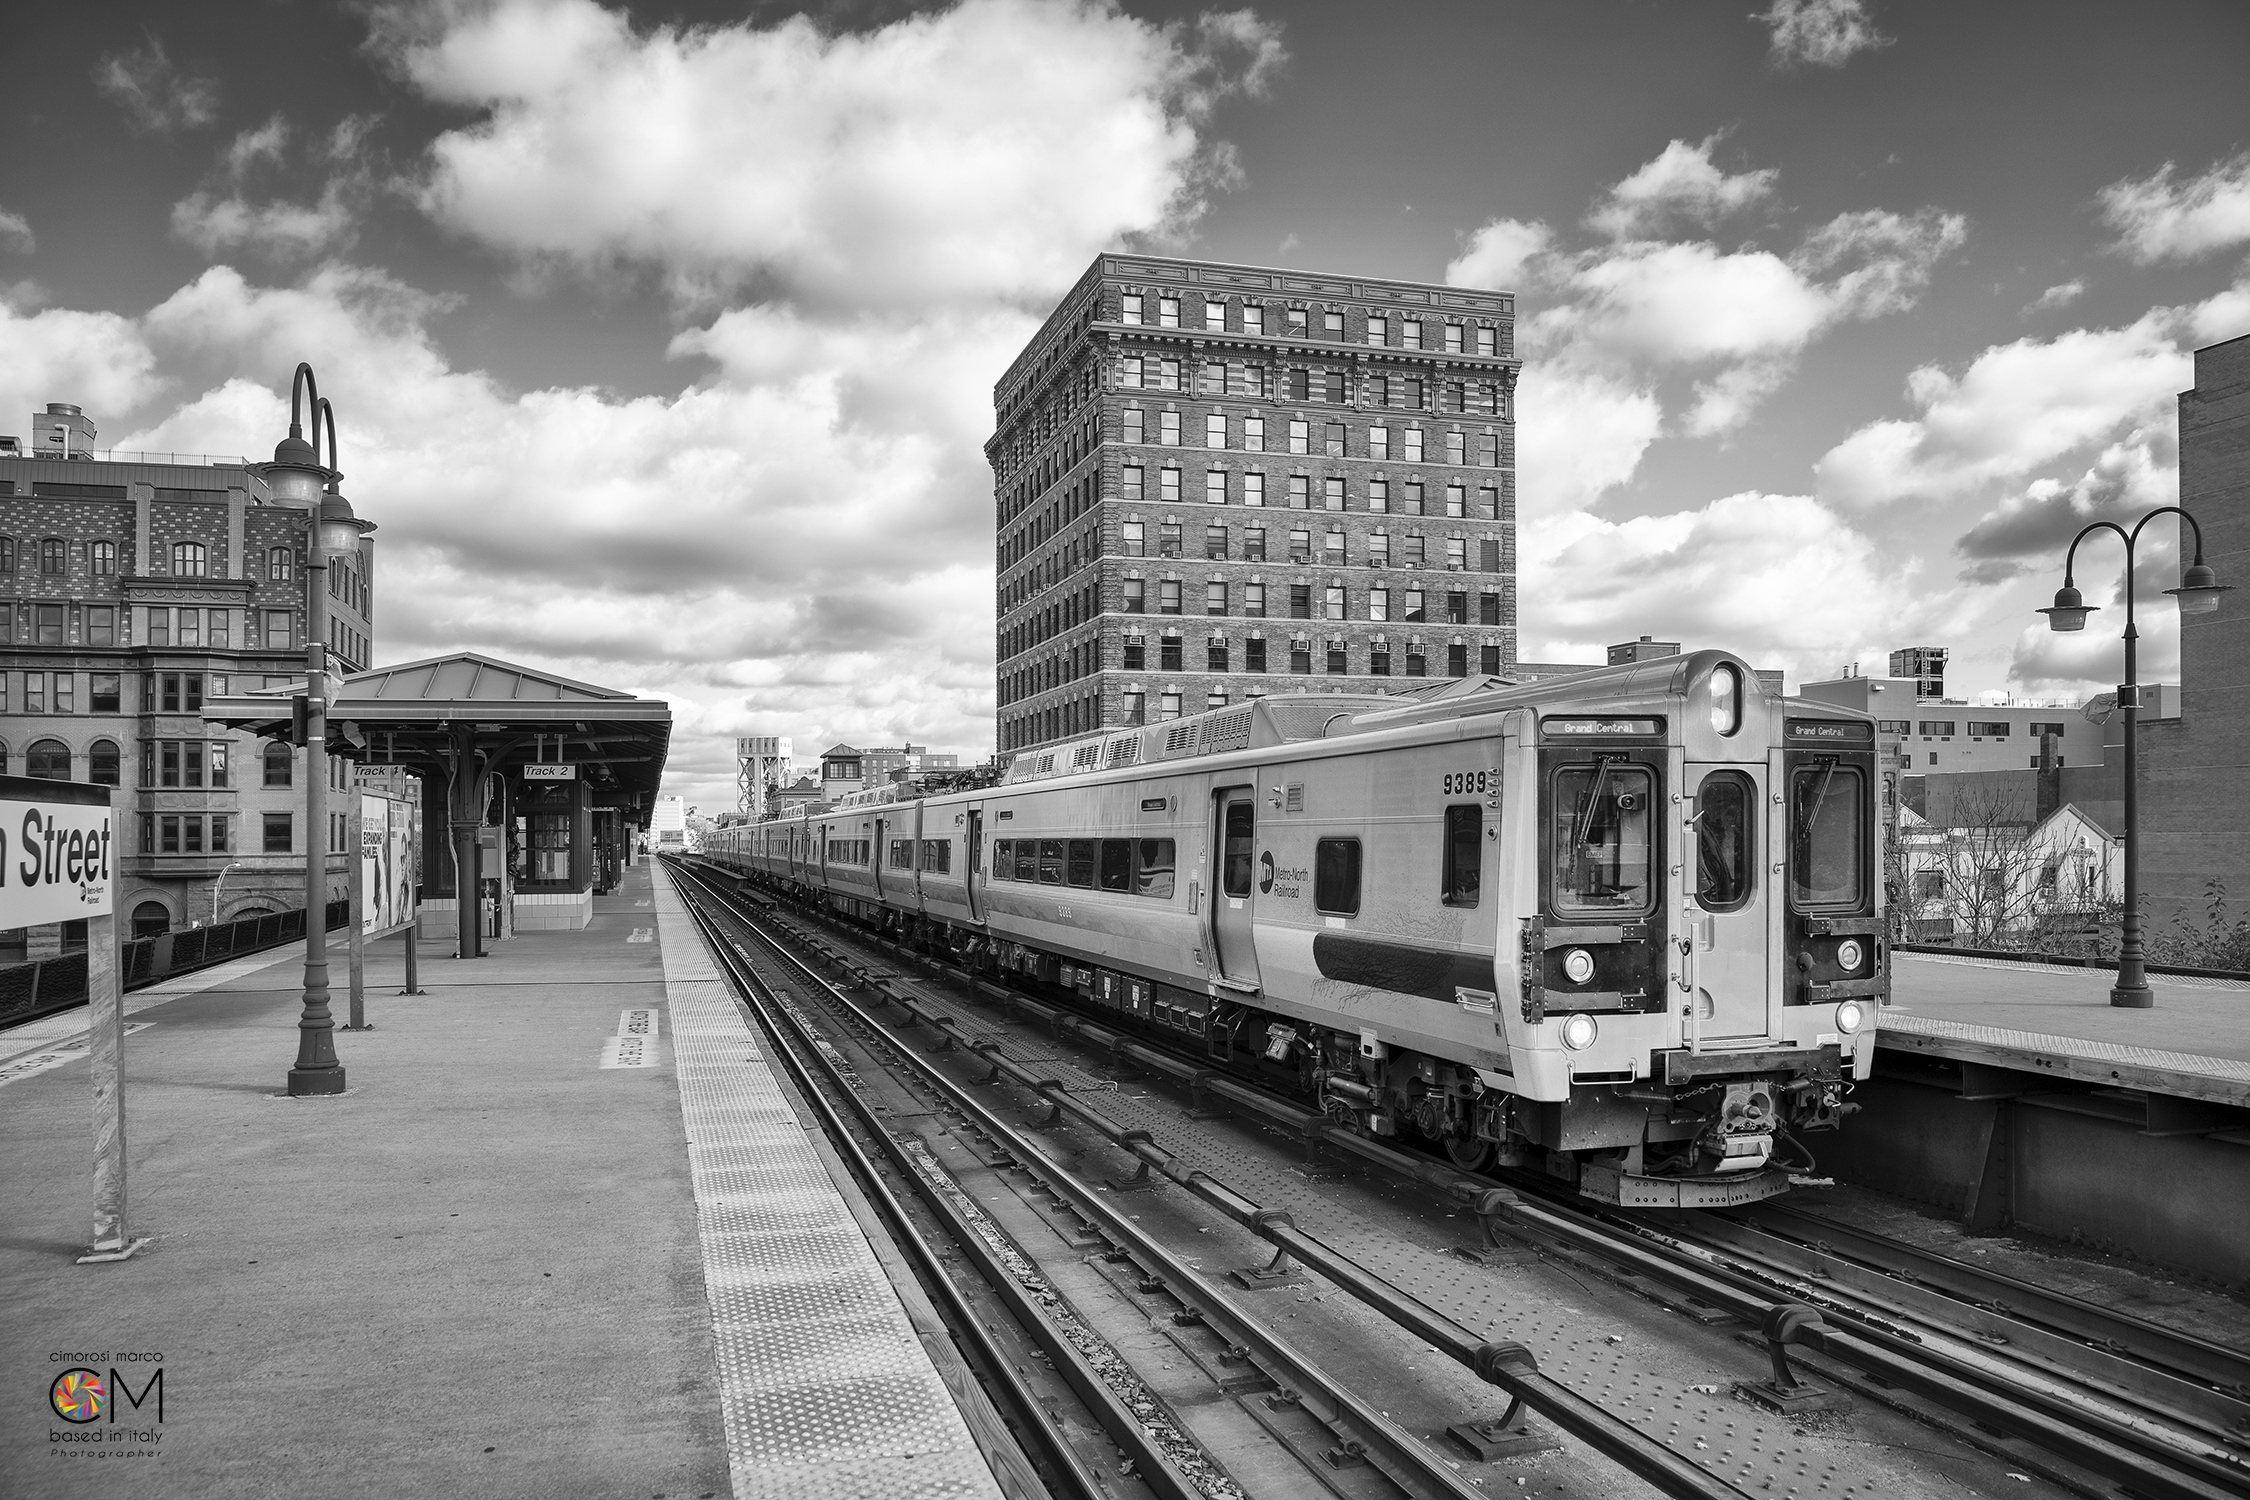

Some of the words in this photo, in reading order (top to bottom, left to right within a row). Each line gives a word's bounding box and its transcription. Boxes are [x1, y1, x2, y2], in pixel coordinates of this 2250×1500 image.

[1564, 723, 1592, 733] Grand
[1596, 723, 1633, 733] Central
[1795, 725, 1816, 735] Grand
[1818, 726, 1844, 736] Central
[353, 766, 386, 776] Track
[393, 766, 399, 775] 1
[525, 766, 555, 776] Track
[560, 766, 568, 776] 2
[1443, 771, 1486, 795] 9389
[20, 807, 110, 888] Street
[1275, 866, 1309, 881] Metro-North
[1274, 883, 1299, 898] Railroad
